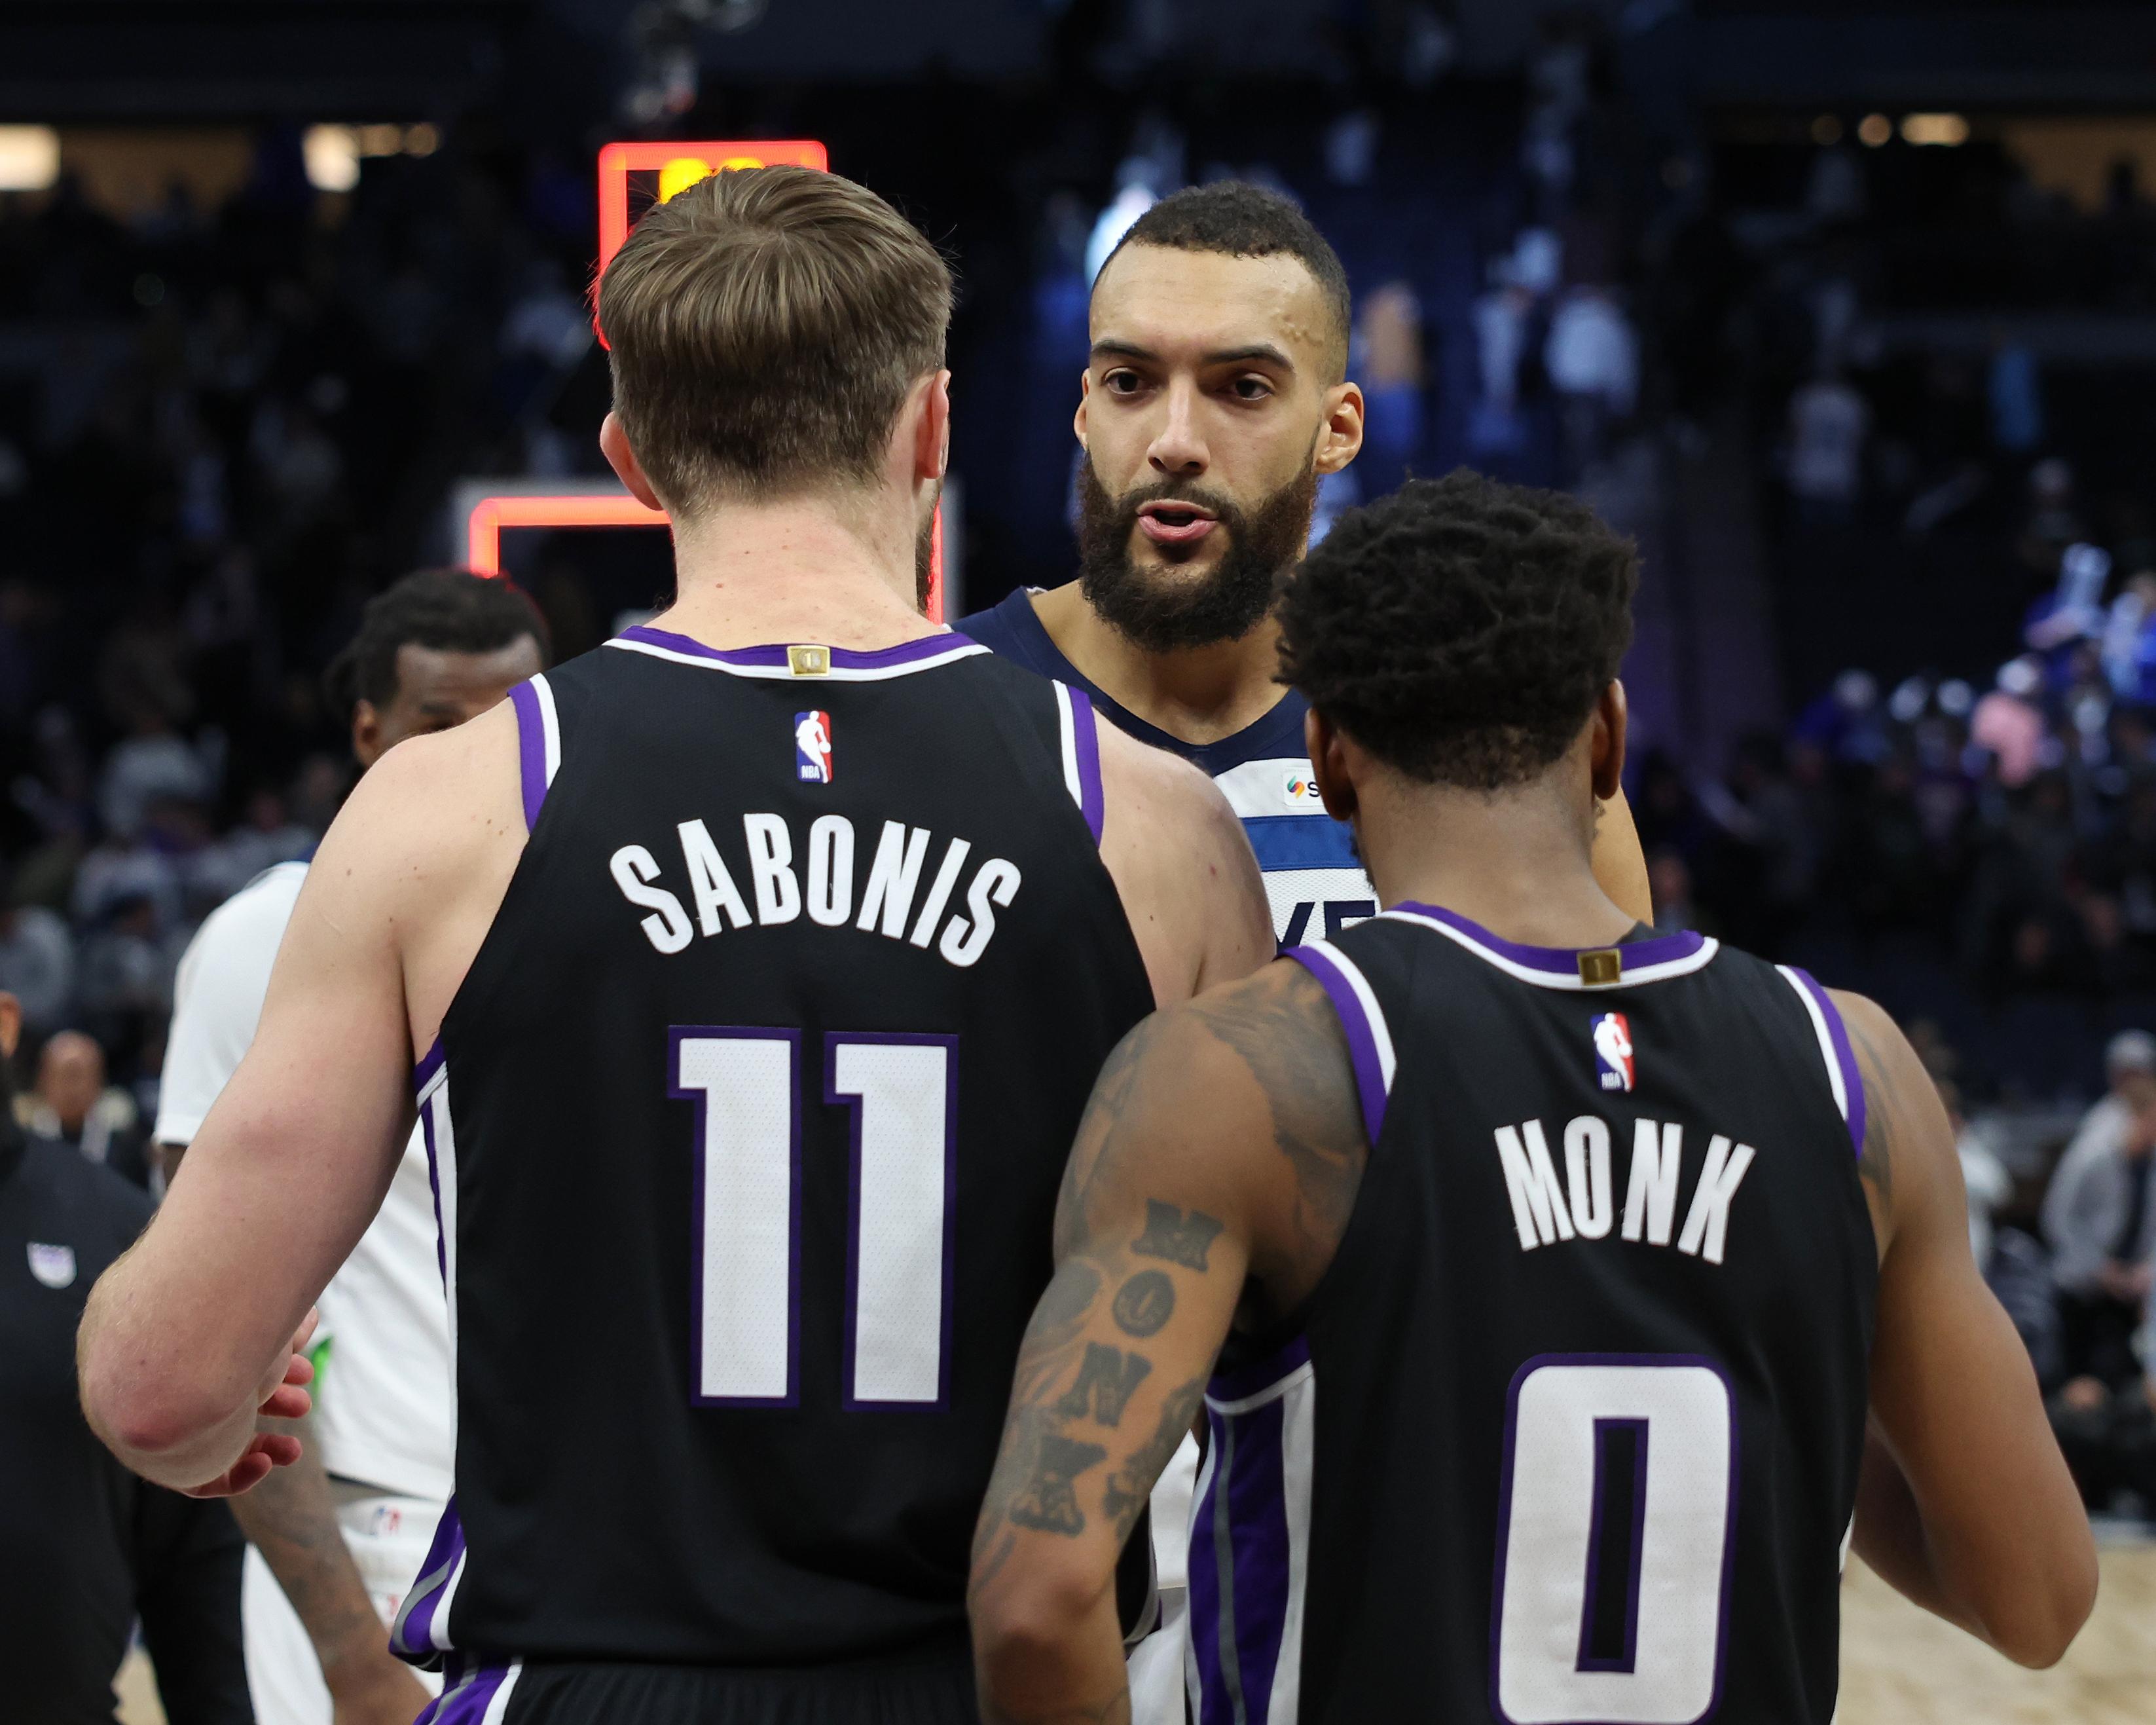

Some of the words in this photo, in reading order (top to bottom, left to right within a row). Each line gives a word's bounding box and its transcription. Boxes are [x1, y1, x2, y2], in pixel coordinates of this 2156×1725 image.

[801, 764, 820, 779] NBA
[610, 813, 1021, 968] SABONIS
[1601, 1071, 1622, 1090] NBA
[667, 1025, 959, 1413] 11
[1493, 1115, 1757, 1266] MONK
[1488, 1352, 1740, 1725] 0
